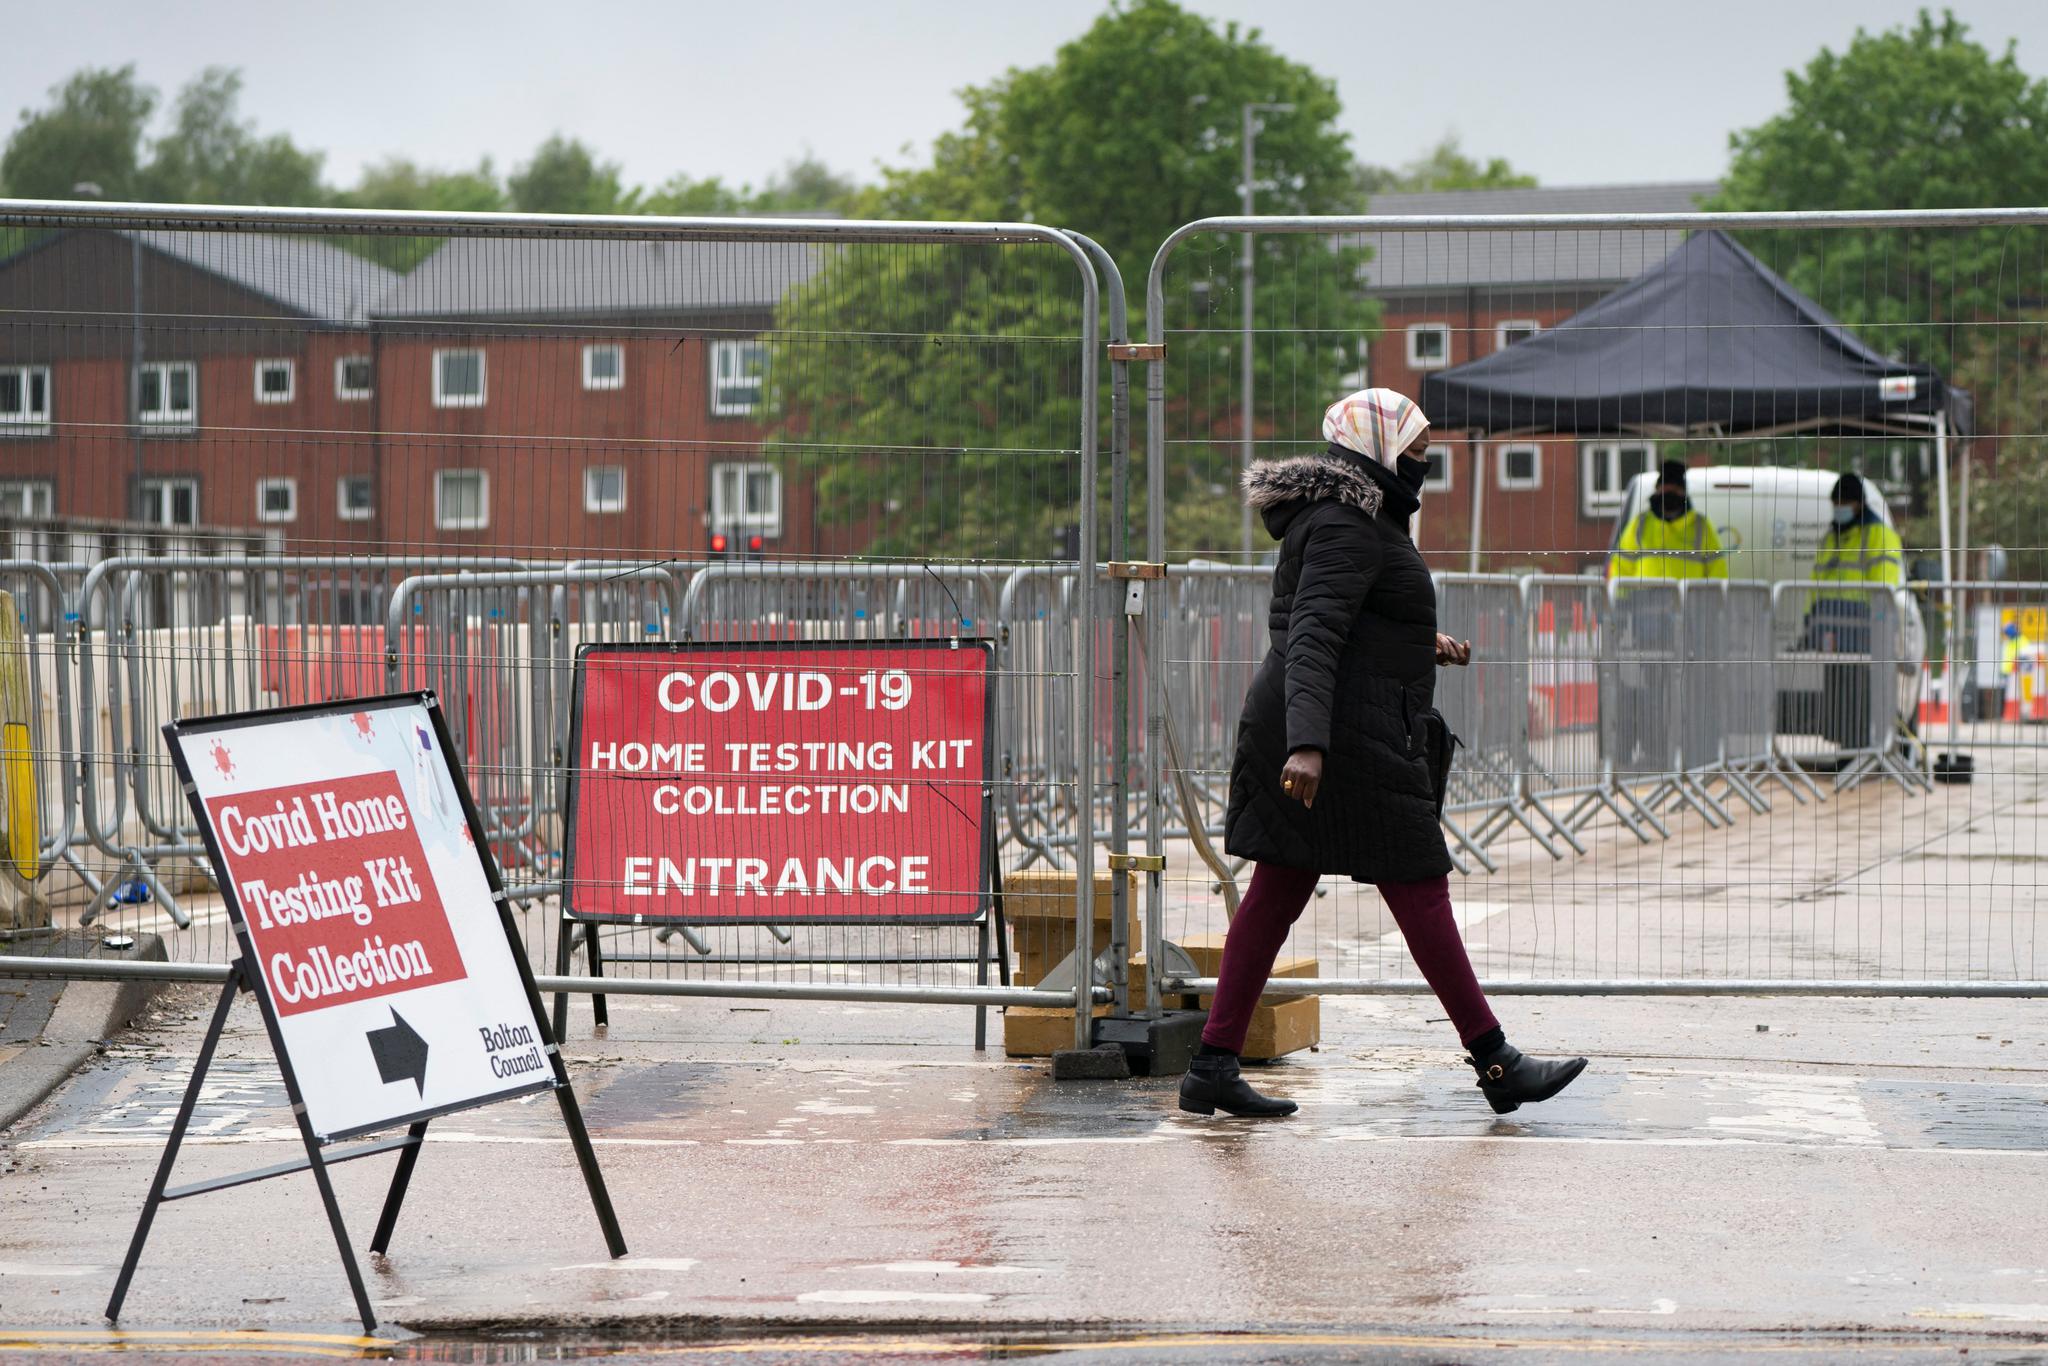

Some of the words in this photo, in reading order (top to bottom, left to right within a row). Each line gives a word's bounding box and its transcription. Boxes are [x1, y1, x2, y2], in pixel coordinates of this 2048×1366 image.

[658, 669, 911, 712] COVID-19
[590, 741, 705, 772] HOME
[725, 742, 893, 771] TESTING
[912, 740, 973, 769] KIT
[653, 784, 909, 815] COLLECTION
[219, 797, 317, 857] Covid
[310, 792, 407, 842] Home
[242, 870, 372, 929] Testing
[363, 855, 422, 908] Kit
[623, 856, 929, 896] ENTRANCE
[270, 935, 433, 1004] Collection
[479, 1023, 534, 1053] Bolton
[490, 1048, 545, 1079] Council
